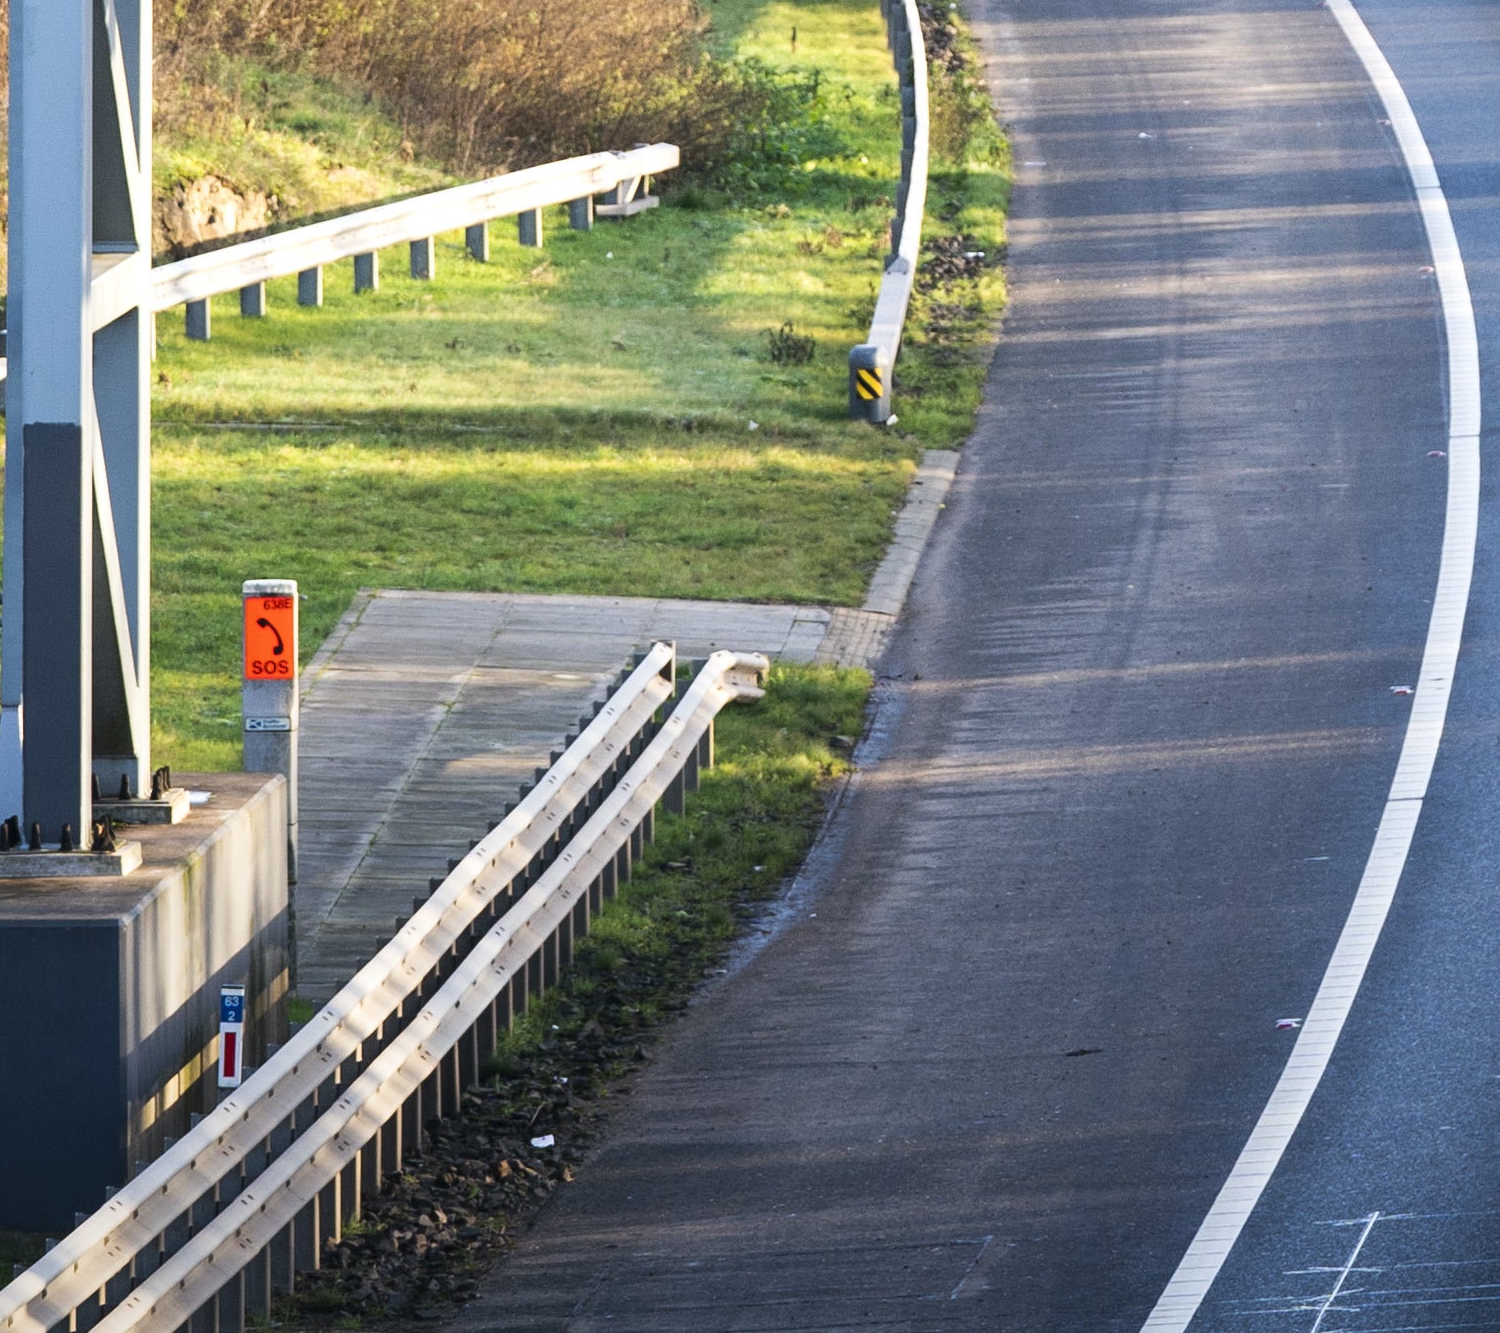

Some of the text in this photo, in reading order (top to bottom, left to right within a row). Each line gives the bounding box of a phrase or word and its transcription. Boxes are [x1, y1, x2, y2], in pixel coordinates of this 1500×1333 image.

[263, 599, 292, 610] 638E
[252, 660, 289, 675] SOS
[225, 997, 239, 1007] 63
[228, 1011, 236, 1021] 2
